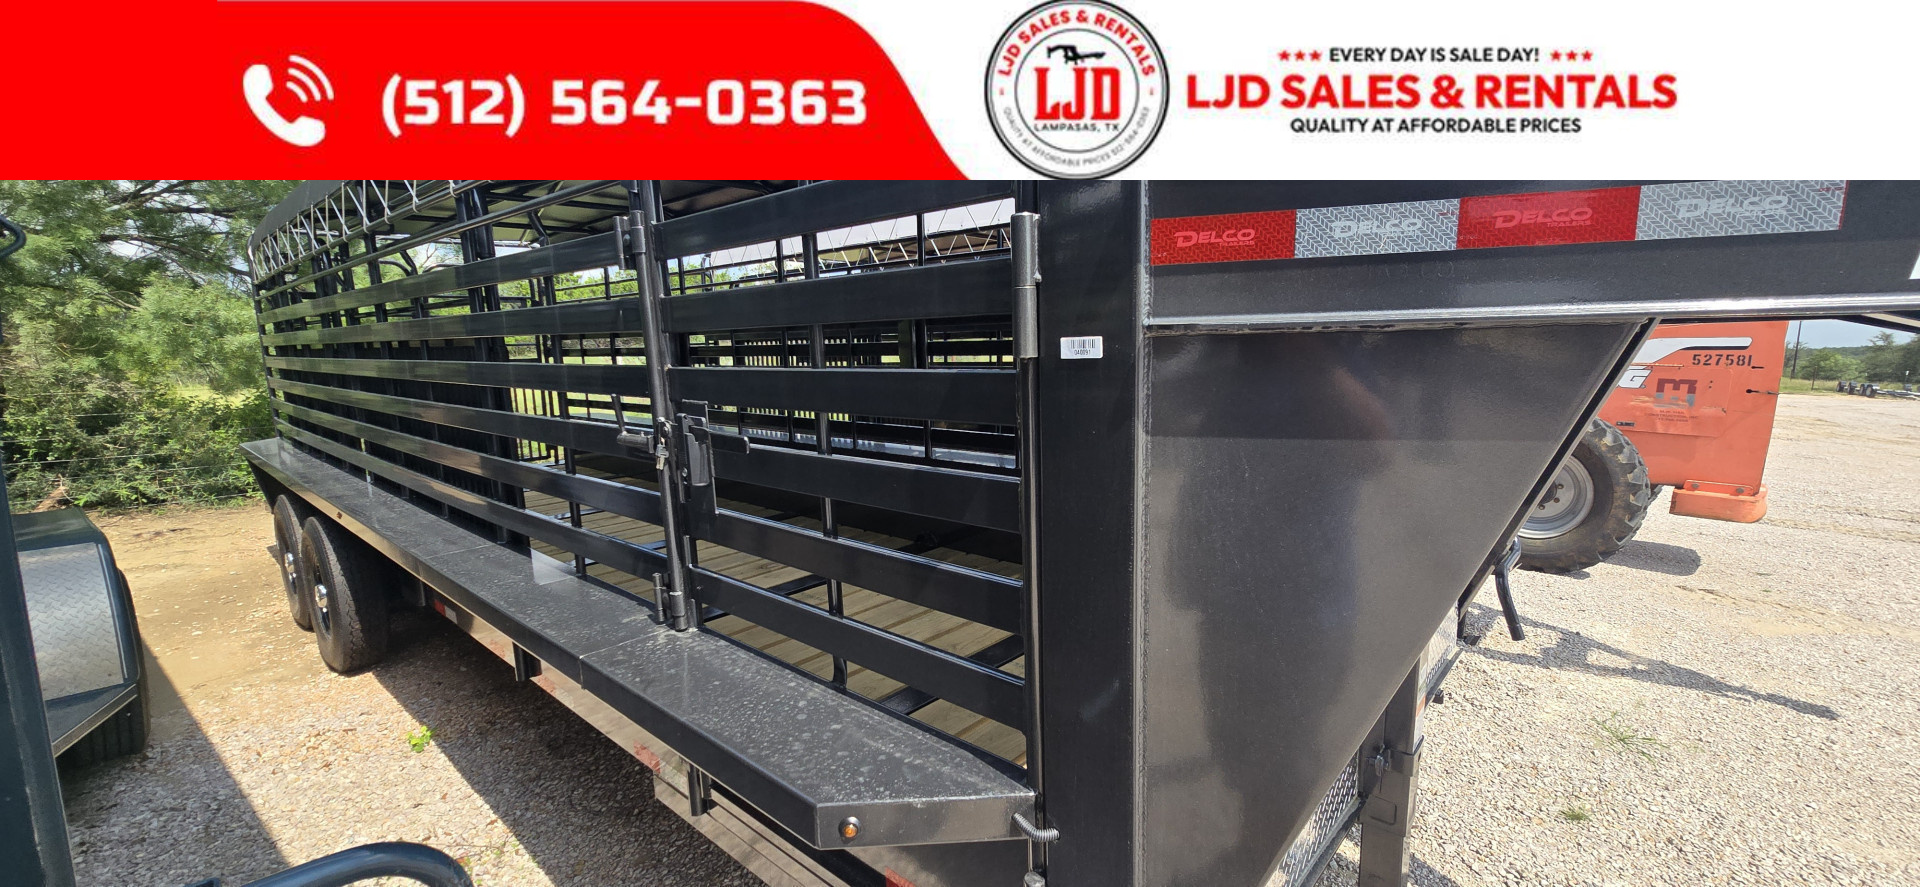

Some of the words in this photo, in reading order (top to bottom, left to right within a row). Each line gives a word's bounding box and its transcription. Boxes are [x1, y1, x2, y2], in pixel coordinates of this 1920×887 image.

[1674, 195, 1789, 217] DELCO
[1331, 218, 1422, 238] DELCO
[1493, 207, 1593, 229] DELCO
[1173, 228, 1256, 248] DELCO
